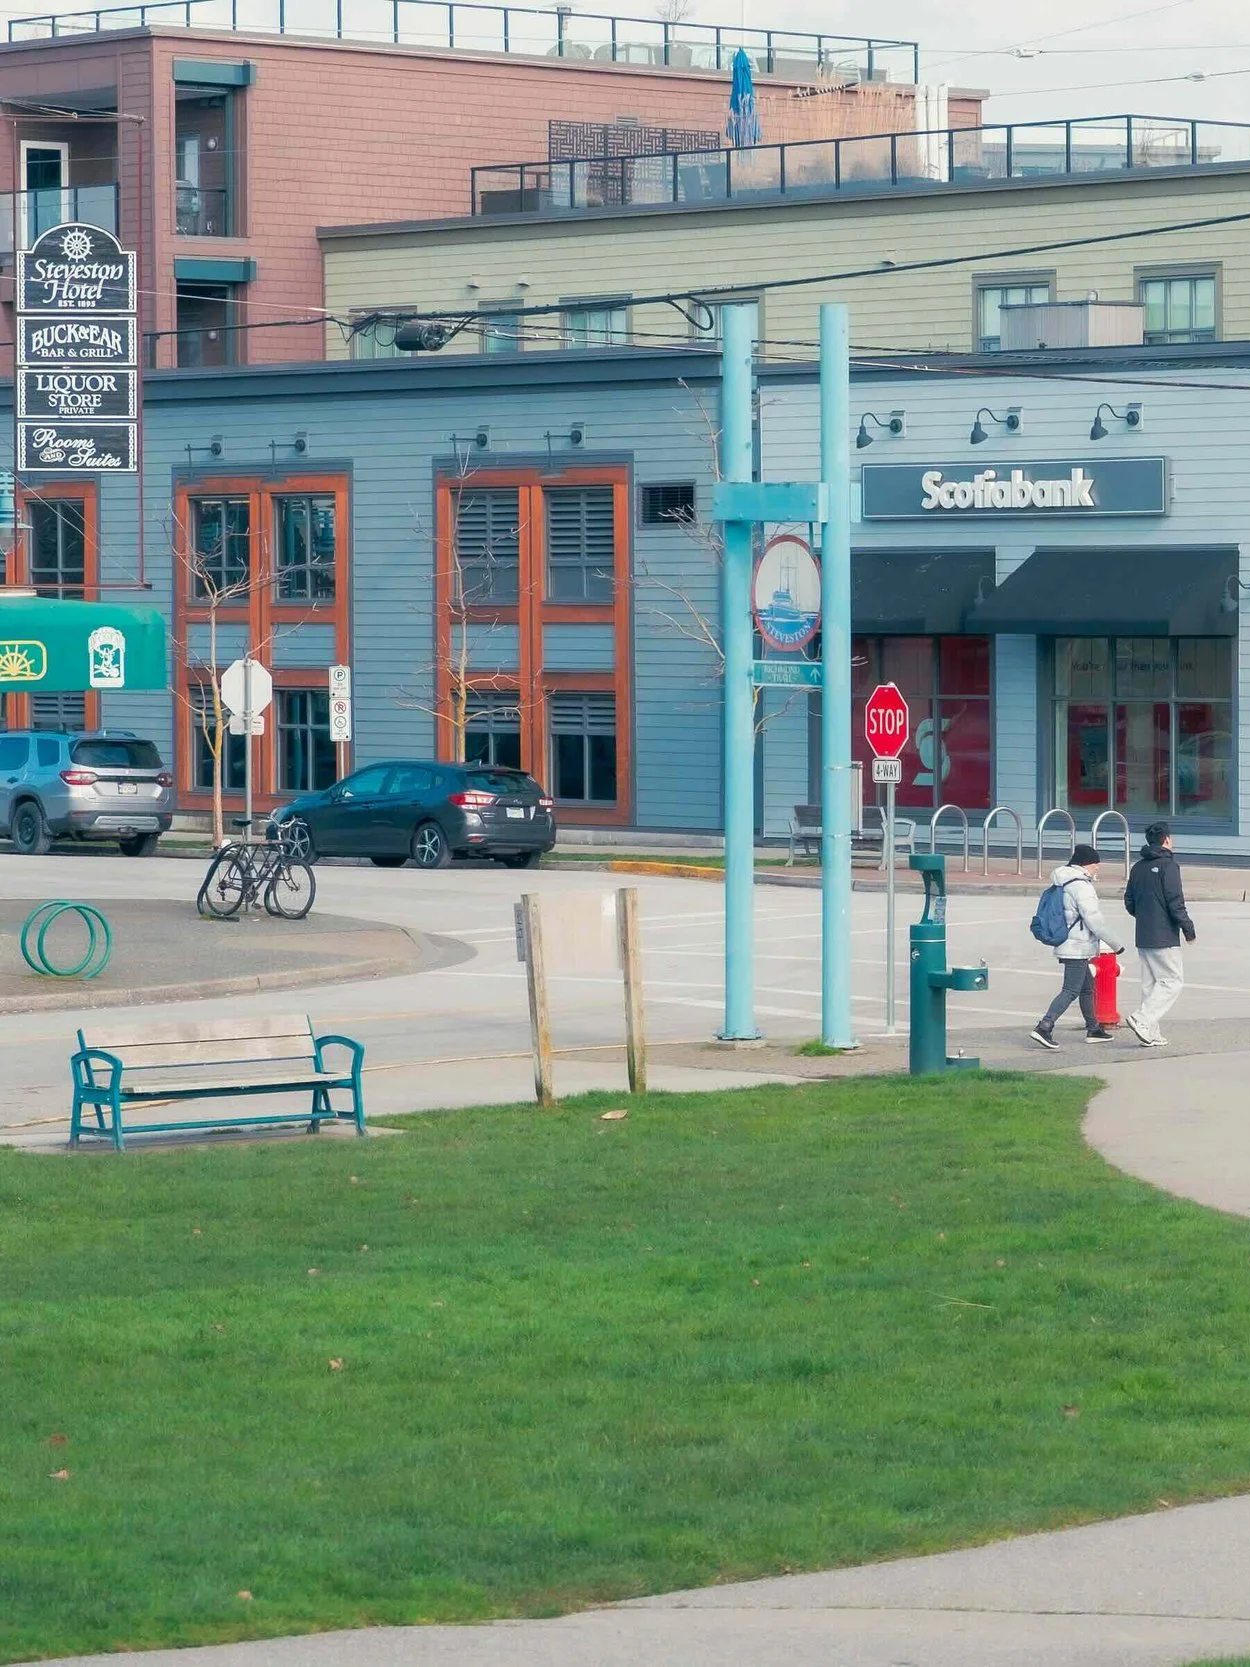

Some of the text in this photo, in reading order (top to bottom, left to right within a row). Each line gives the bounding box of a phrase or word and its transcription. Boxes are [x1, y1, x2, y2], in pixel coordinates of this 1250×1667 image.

[30, 259, 124, 281] Steveston
[42, 278, 103, 303] Hotel
[41, 348, 113, 357] BAR & GRILL
[35, 375, 118, 394] LIQUOR
[48, 394, 102, 407] STORE
[32, 428, 95, 448] Rooms
[68, 447, 122, 467] Suites
[921, 468, 1095, 510] Scotiabank
[765, 621, 811, 644] STEVESTON
[869, 708, 904, 735] STOP
[876, 764, 898, 777] 4-WAY
